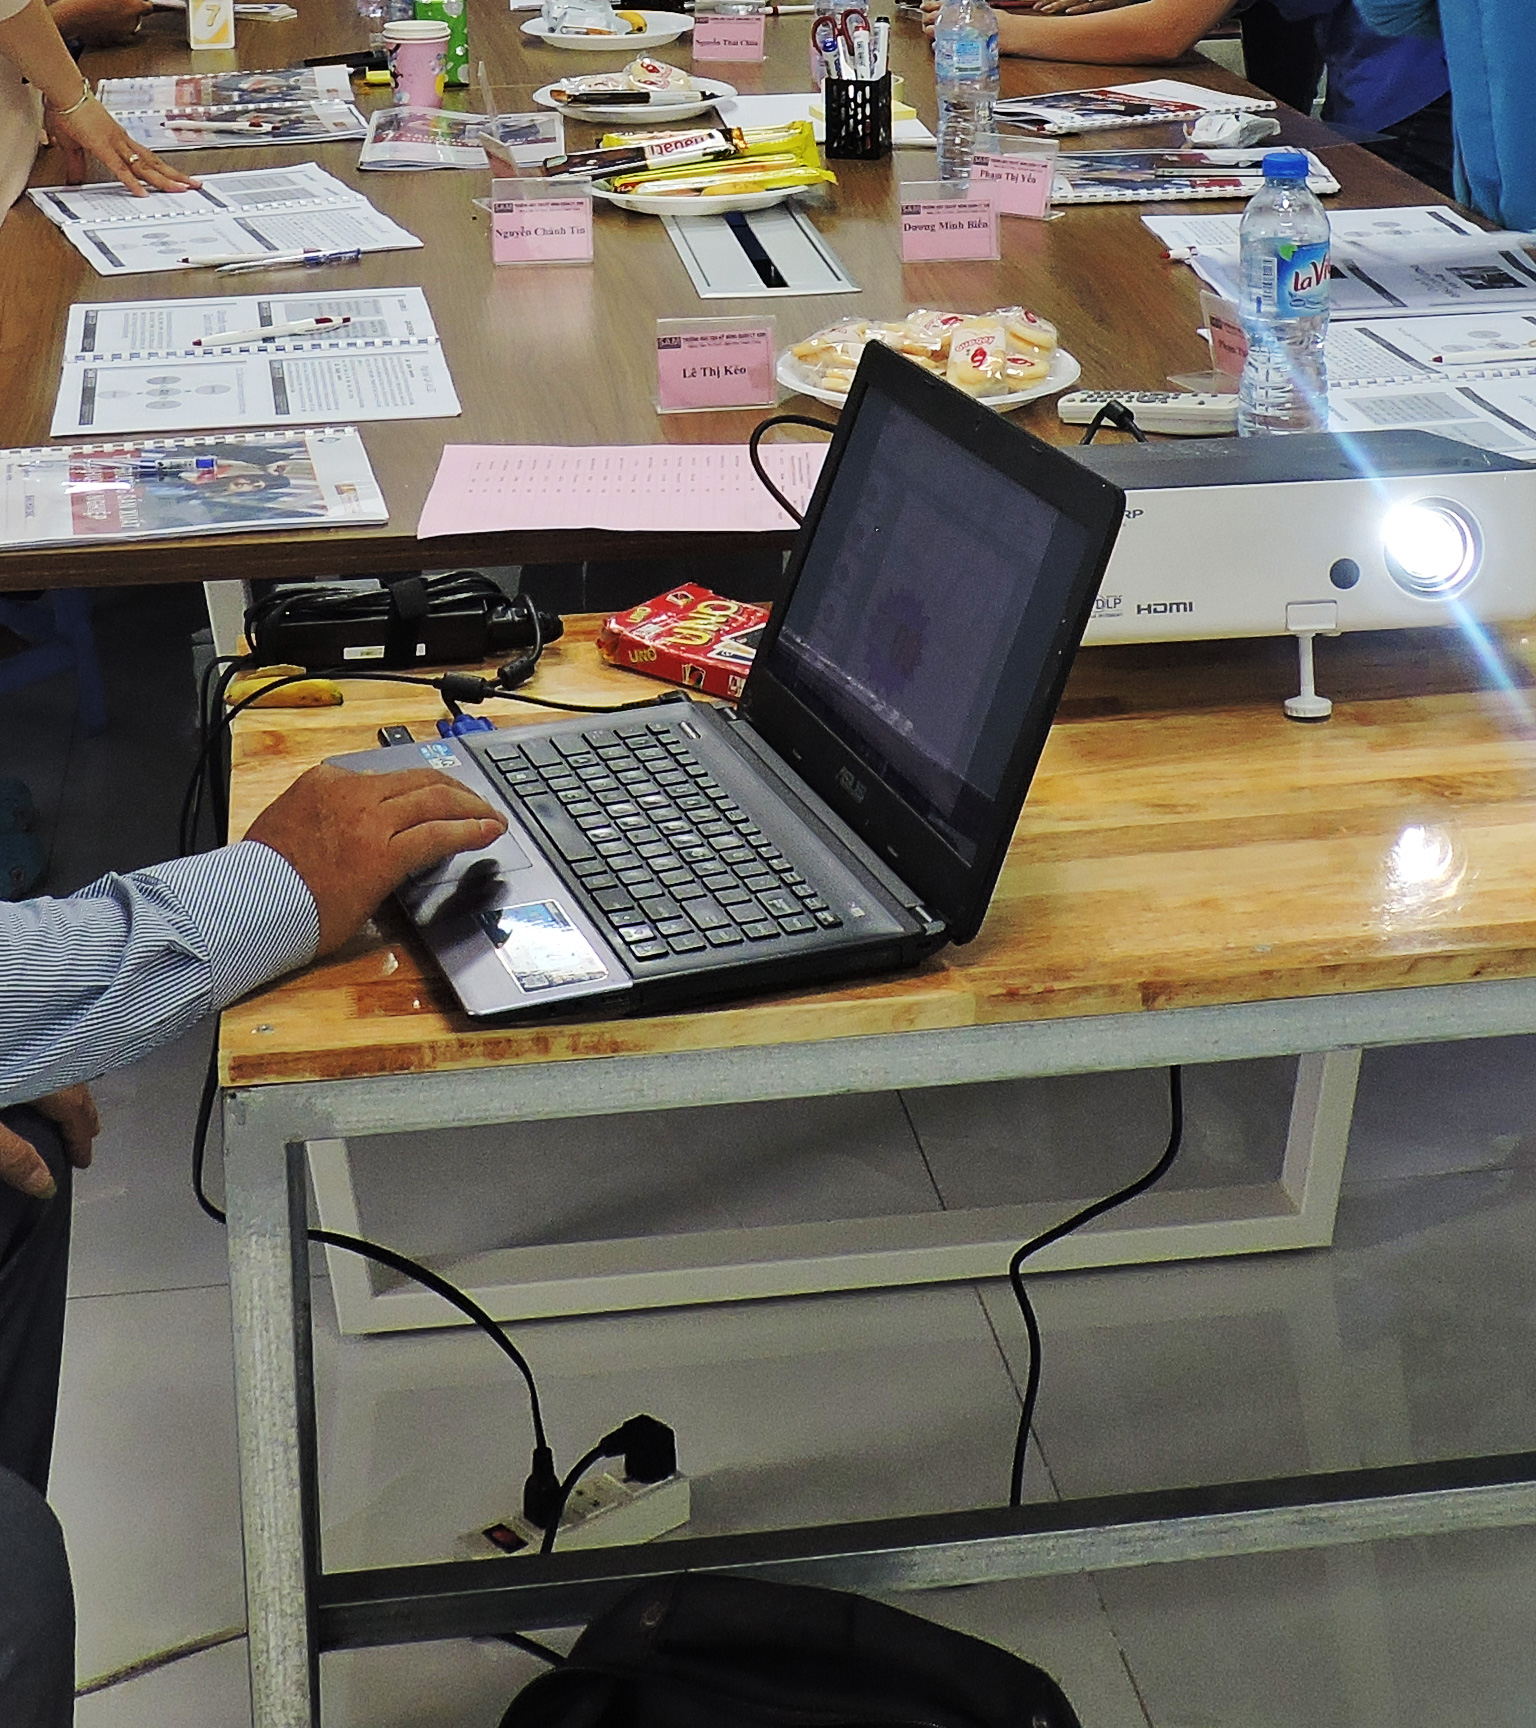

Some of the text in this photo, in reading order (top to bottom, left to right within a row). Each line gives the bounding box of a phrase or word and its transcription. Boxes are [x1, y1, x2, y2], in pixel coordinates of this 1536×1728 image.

[206, 4, 221, 27] 7
[1096, 598, 1193, 615] DLP HDMI
[667, 600, 741, 646] UNO
[628, 648, 658, 664] UNO
